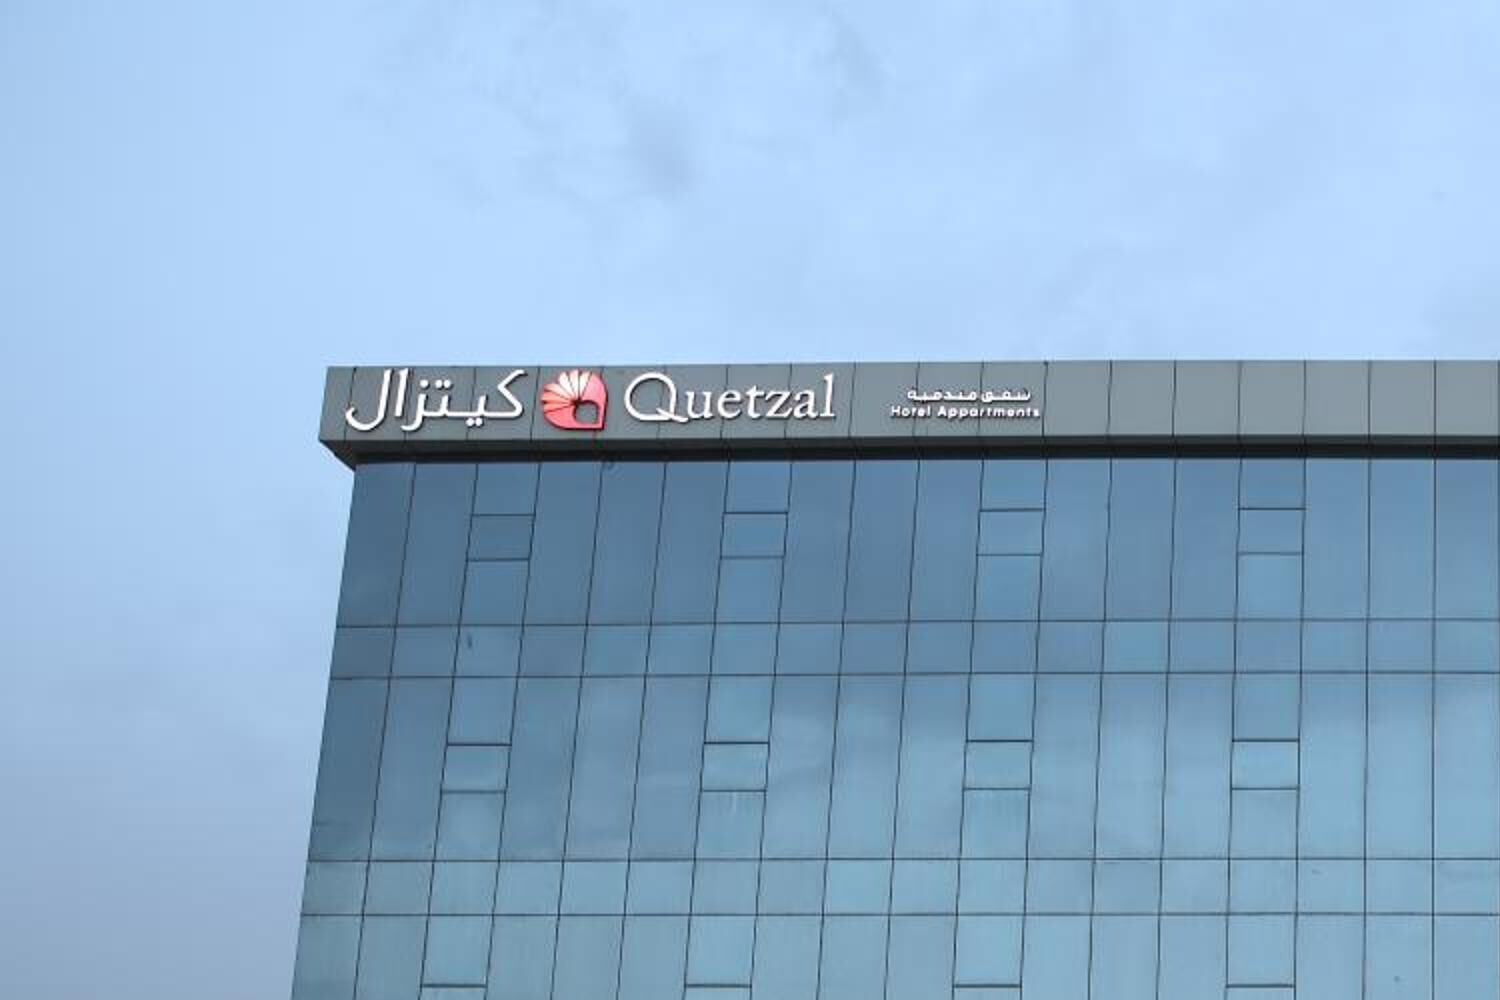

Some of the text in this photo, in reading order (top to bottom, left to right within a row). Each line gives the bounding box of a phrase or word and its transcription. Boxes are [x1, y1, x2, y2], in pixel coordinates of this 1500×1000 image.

[345, 368, 527, 431] كيتزال
[623, 372, 836, 424] Quetzal
[891, 405, 1040, 420] Hotel Appartments
